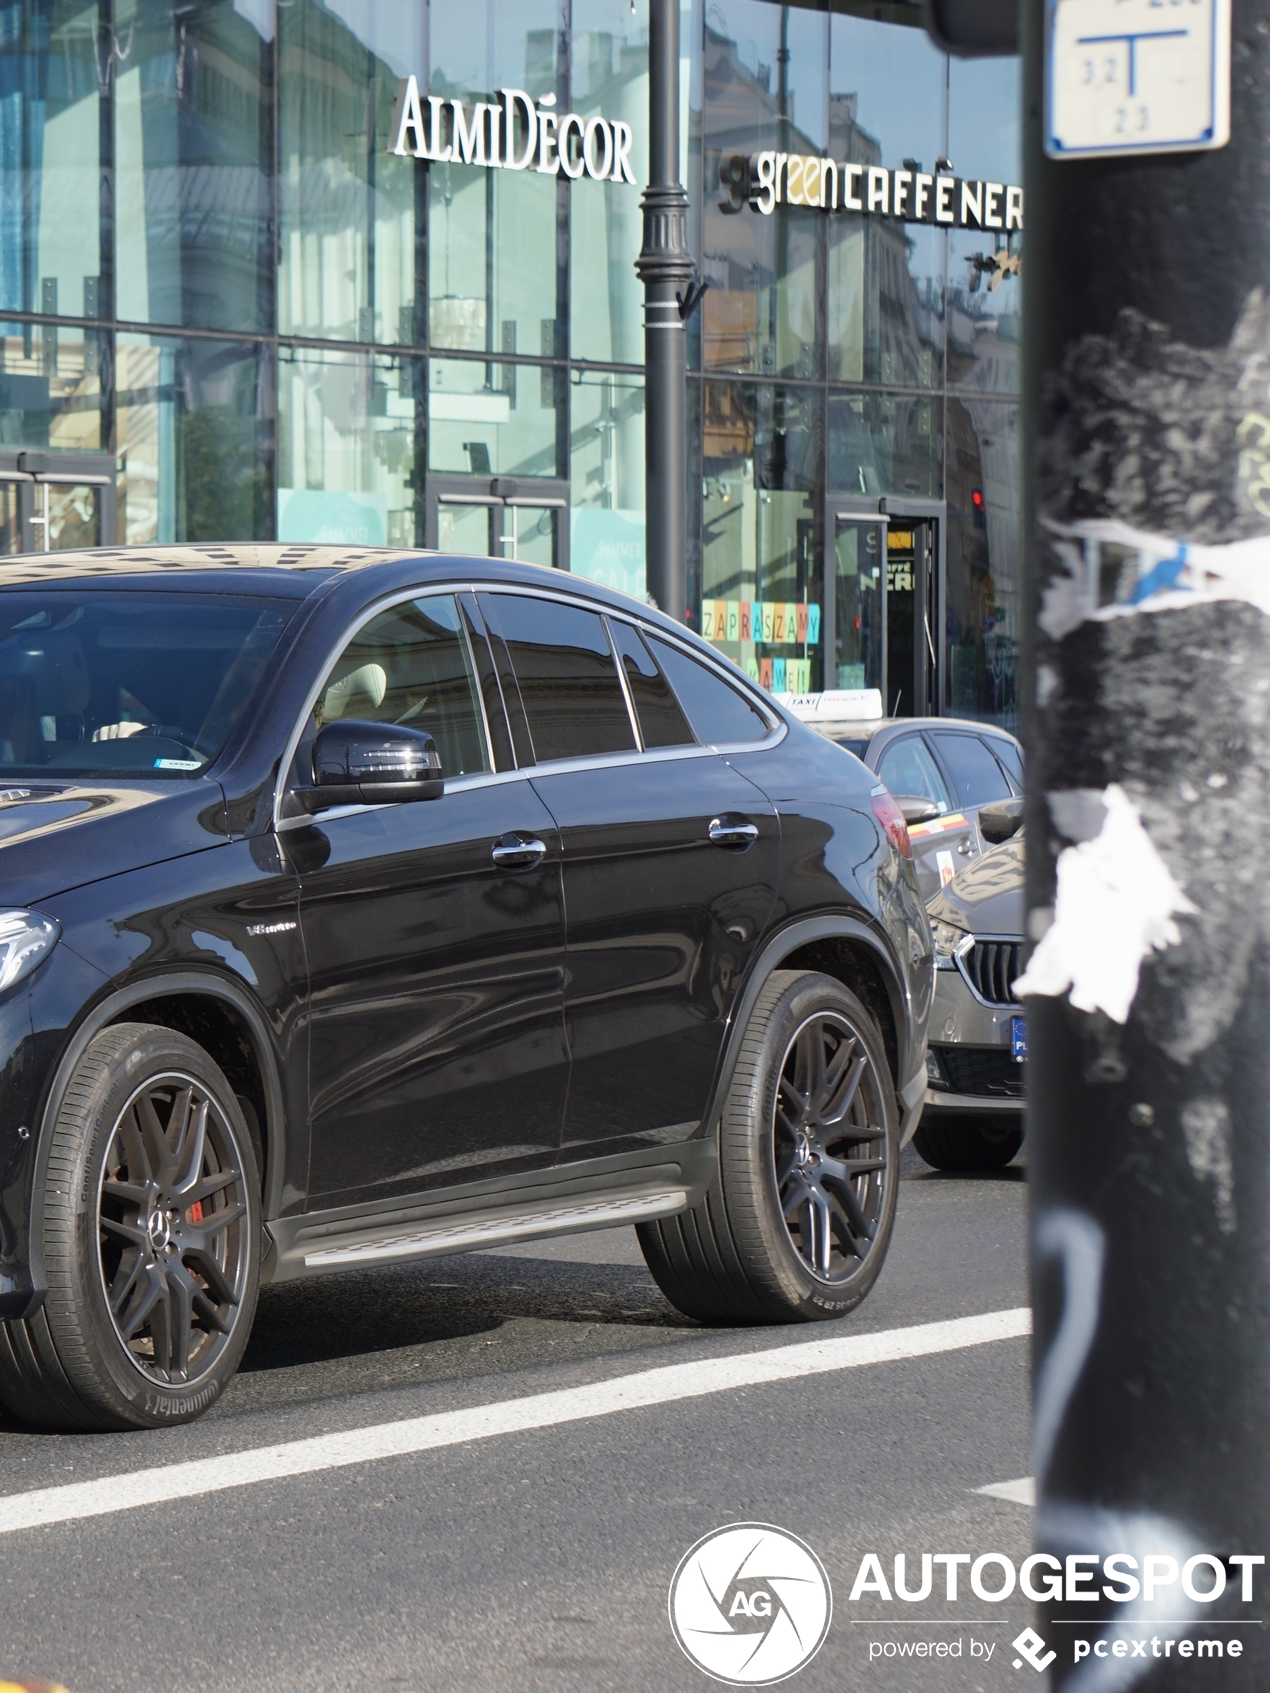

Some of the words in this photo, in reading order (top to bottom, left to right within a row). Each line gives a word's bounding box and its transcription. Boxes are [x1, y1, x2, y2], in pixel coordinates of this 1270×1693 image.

[757, 150, 838, 216] green
[960, 180, 1024, 230] NER
[703, 612, 818, 639] ZAPRASZAMY
[792, 698, 816, 706] TAXI
[1016, 1041, 1028, 1050] PL
[152, 1379, 219, 1416] Continental
